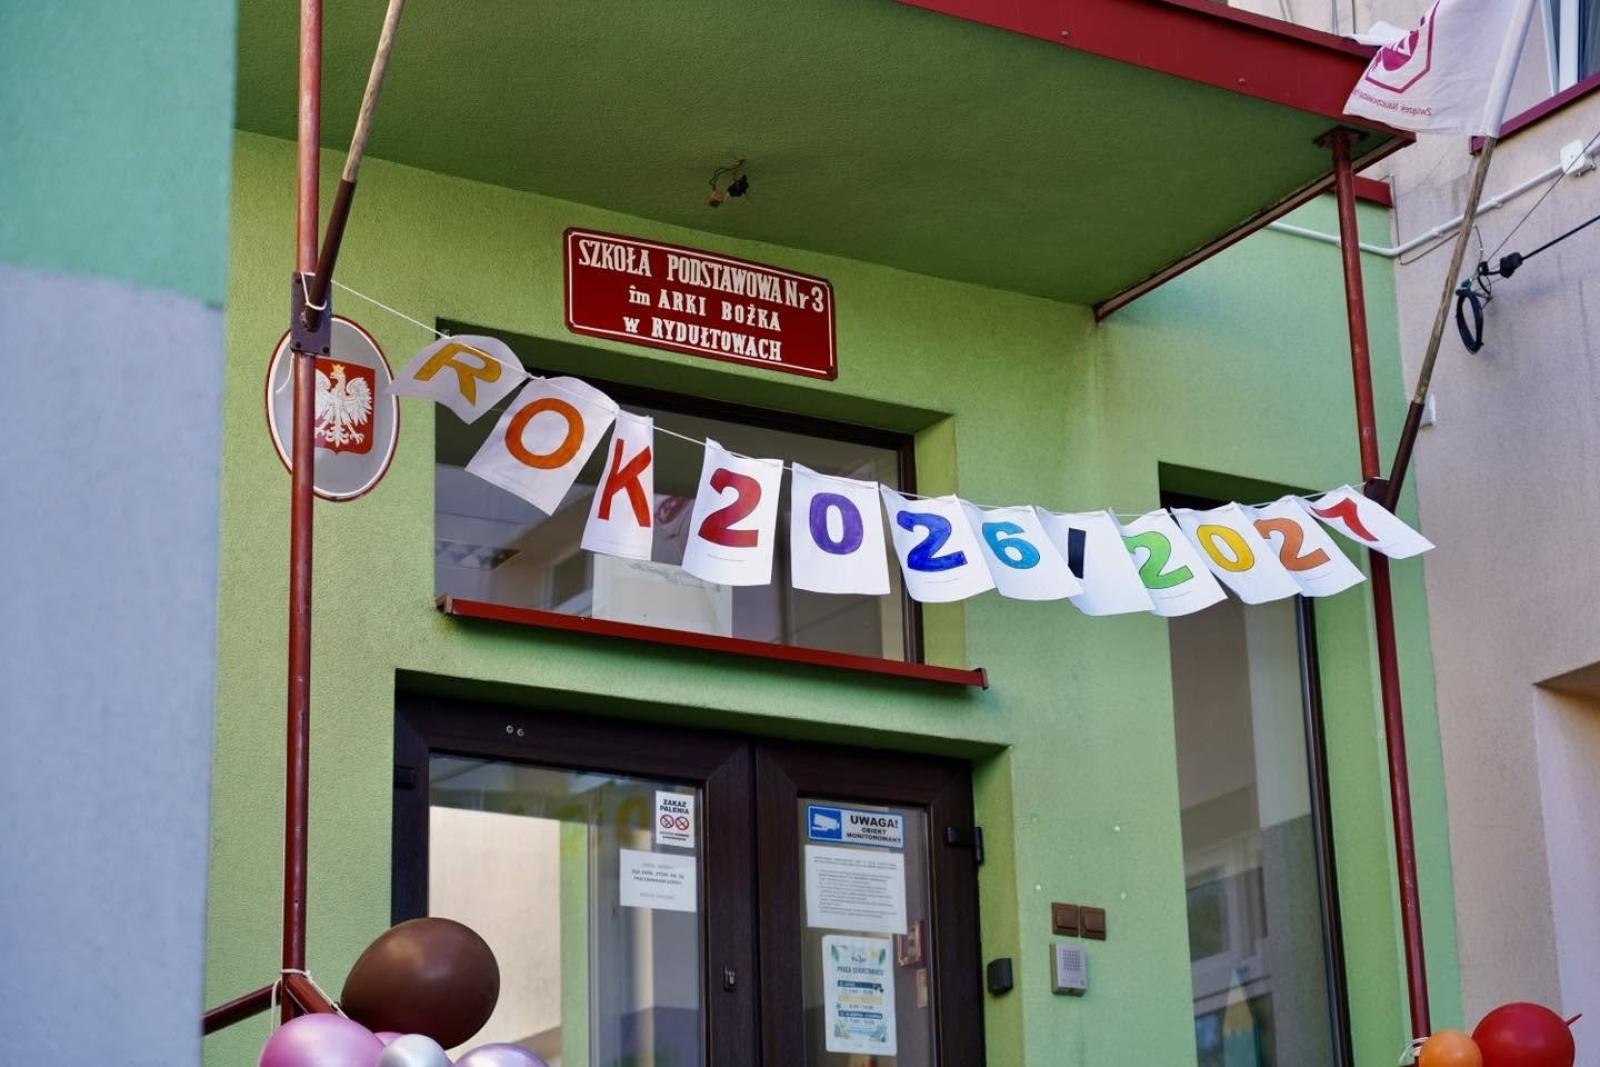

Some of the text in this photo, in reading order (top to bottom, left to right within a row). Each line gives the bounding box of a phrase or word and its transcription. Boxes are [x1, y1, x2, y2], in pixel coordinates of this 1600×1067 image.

[578, 239, 825, 313] SZKOŁA PODSTAWOWA Nr 3
[628, 285, 781, 331] im ARKI BOŻKA
[651, 317, 782, 361] RYDUŁTOWACH
[413, 342, 653, 528] ROK
[659, 805, 690, 814] PALENIA
[662, 799, 688, 808] ZAKAZ
[850, 814, 898, 829] UWAGA!
[861, 827, 887, 836] OBIEKT
